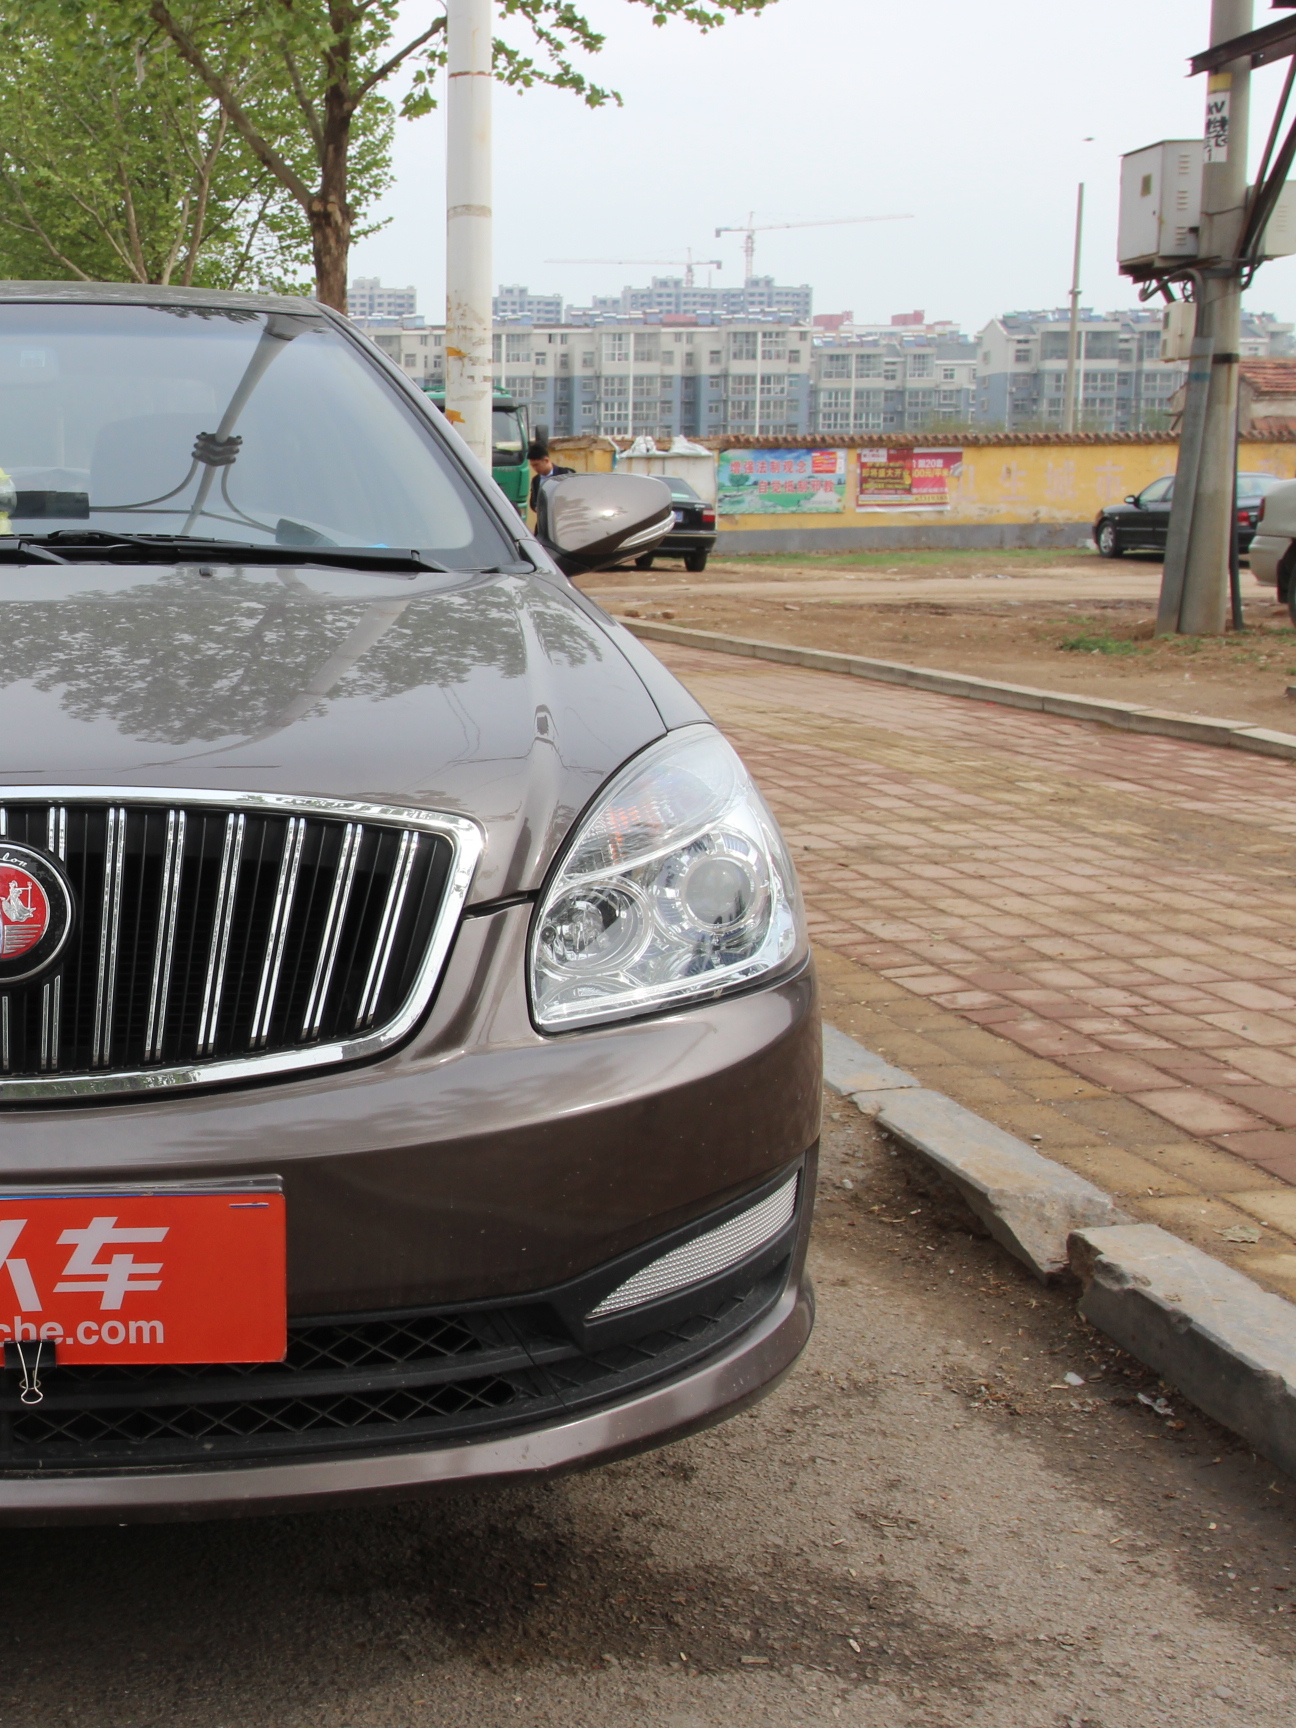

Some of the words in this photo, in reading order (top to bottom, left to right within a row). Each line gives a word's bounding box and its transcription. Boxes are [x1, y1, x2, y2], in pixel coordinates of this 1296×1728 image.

[730, 460, 807, 474] 增强法制观念
[758, 479, 835, 494] 自觉抵制邪教
